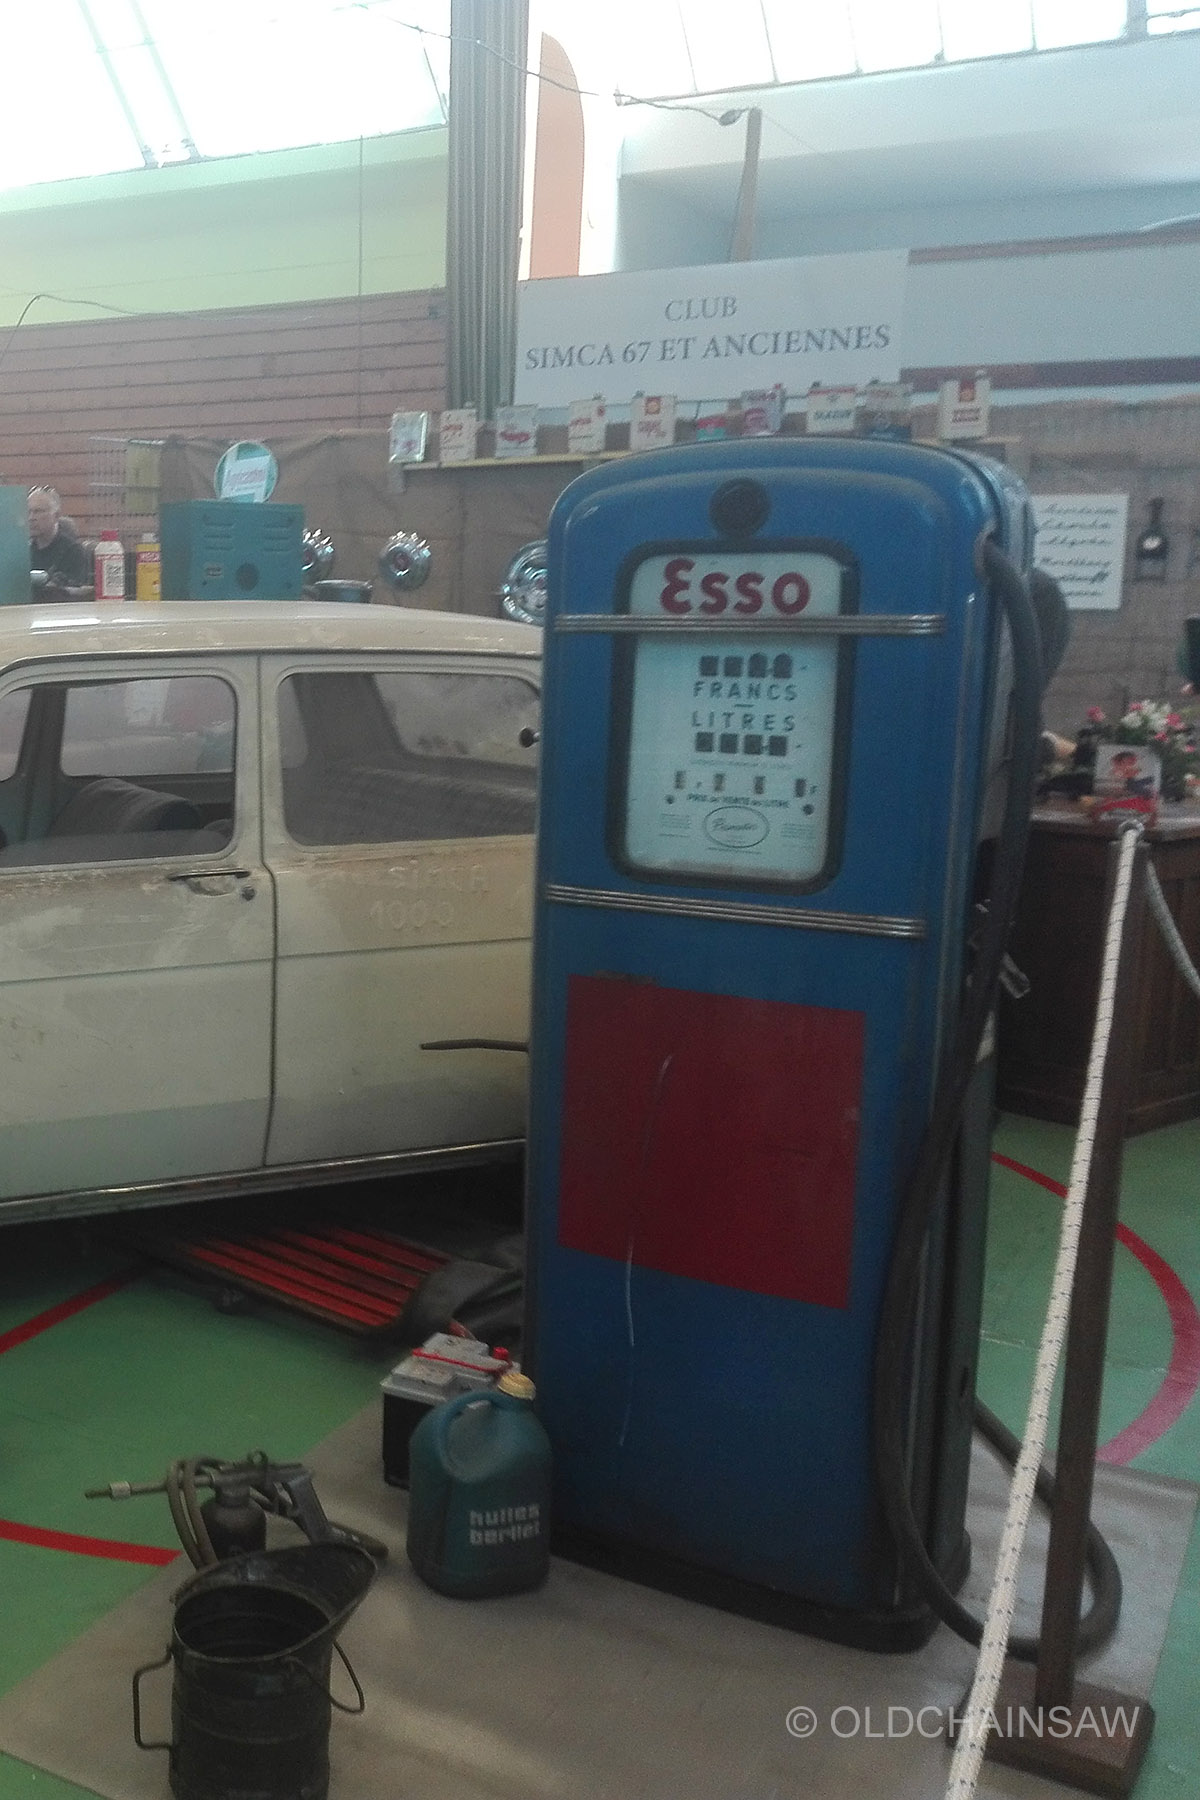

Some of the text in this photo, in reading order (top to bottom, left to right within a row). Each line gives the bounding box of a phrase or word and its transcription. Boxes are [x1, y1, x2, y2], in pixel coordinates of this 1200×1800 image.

[664, 296, 738, 322] CLUB
[525, 324, 891, 370] SIMCA 67 ET ANCIENNES
[693, 681, 798, 701] FRANCS
[691, 711, 796, 731] LITRES
